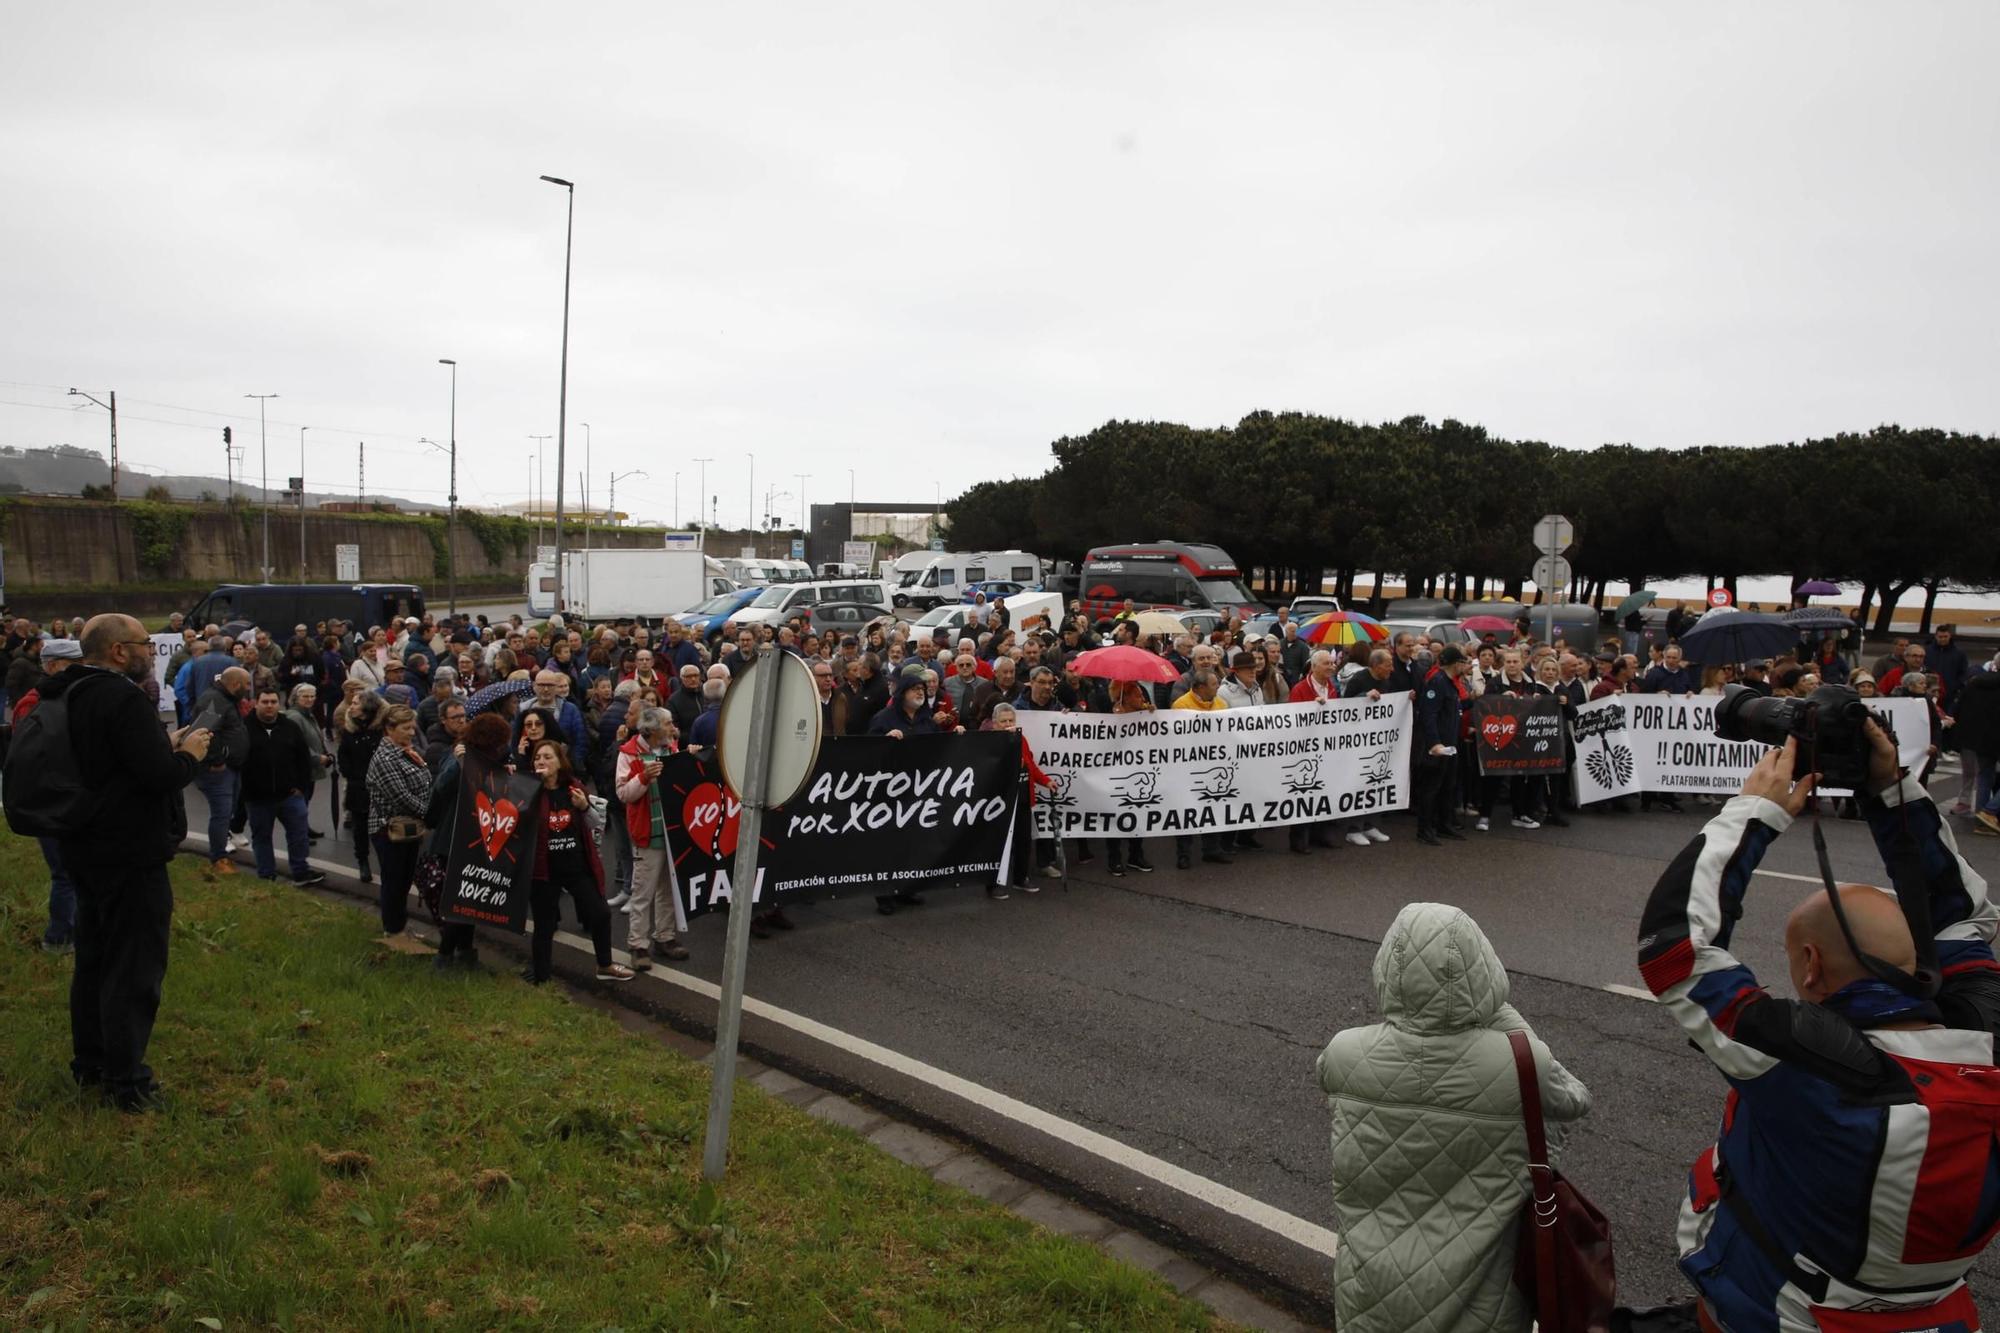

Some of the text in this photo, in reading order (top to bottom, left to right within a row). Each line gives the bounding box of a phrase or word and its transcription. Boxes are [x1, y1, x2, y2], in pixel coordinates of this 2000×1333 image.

[1049, 704, 1394, 740] TAMBIÉN SOMOS GIJÓN Y PAGAMOS IMPUESTOS, PERO
[1483, 722, 1516, 735] XOVE
[1525, 715, 1558, 726] AUTOVIA
[1633, 706, 1663, 729] POR
[1668, 706, 1687, 730] LA
[1525, 728, 1540, 738] POR
[1533, 740, 1549, 752] NO
[1038, 728, 1400, 768] APARECEMOS EN PLANES, INVERSIONES NI PROYECTOS
[1672, 742, 1781, 768] CONTAMIN
[808, 766, 975, 804] AUTOVIA
[1661, 775, 1710, 787] PLATAFORMA
[1712, 776, 1741, 788] CONTRA
[688, 796, 742, 832] XOV
[787, 795, 1007, 839] POR XOVE NO
[1033, 784, 1397, 833] ESPETO PARA LA ZONA OESTE
[549, 843, 564, 851] OVE
[462, 864, 501, 885] AUTOVIA
[775, 862, 1000, 892] FEDERACIÓN GIJONESA DE ASOCIACIONES VECINALE
[457, 880, 507, 906] XOVE NO
